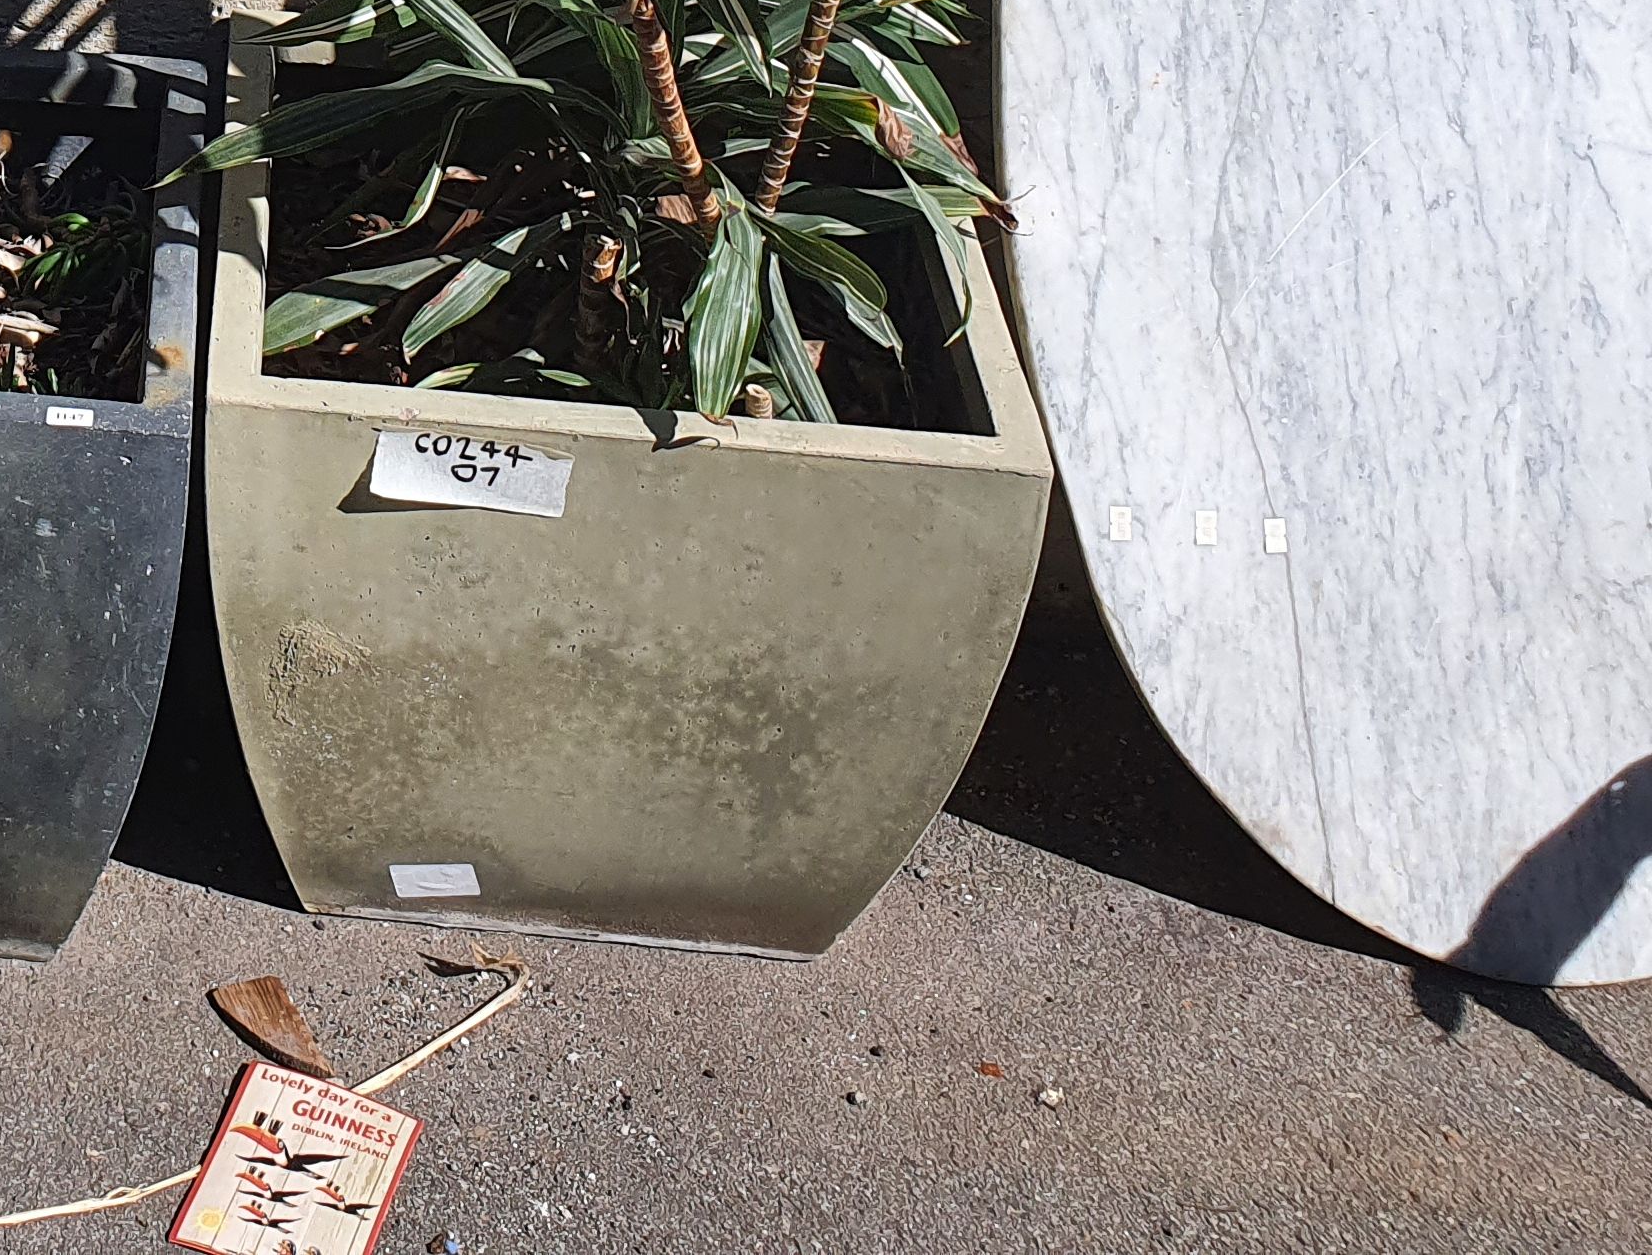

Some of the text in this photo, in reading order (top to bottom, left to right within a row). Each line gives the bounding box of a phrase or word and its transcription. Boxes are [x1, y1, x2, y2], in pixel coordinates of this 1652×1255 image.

[261, 1068, 392, 1123] Lovely day for a
[291, 1123, 389, 1161] DUBLIN, IRELAND
[292, 1099, 398, 1147] GUINNESS
